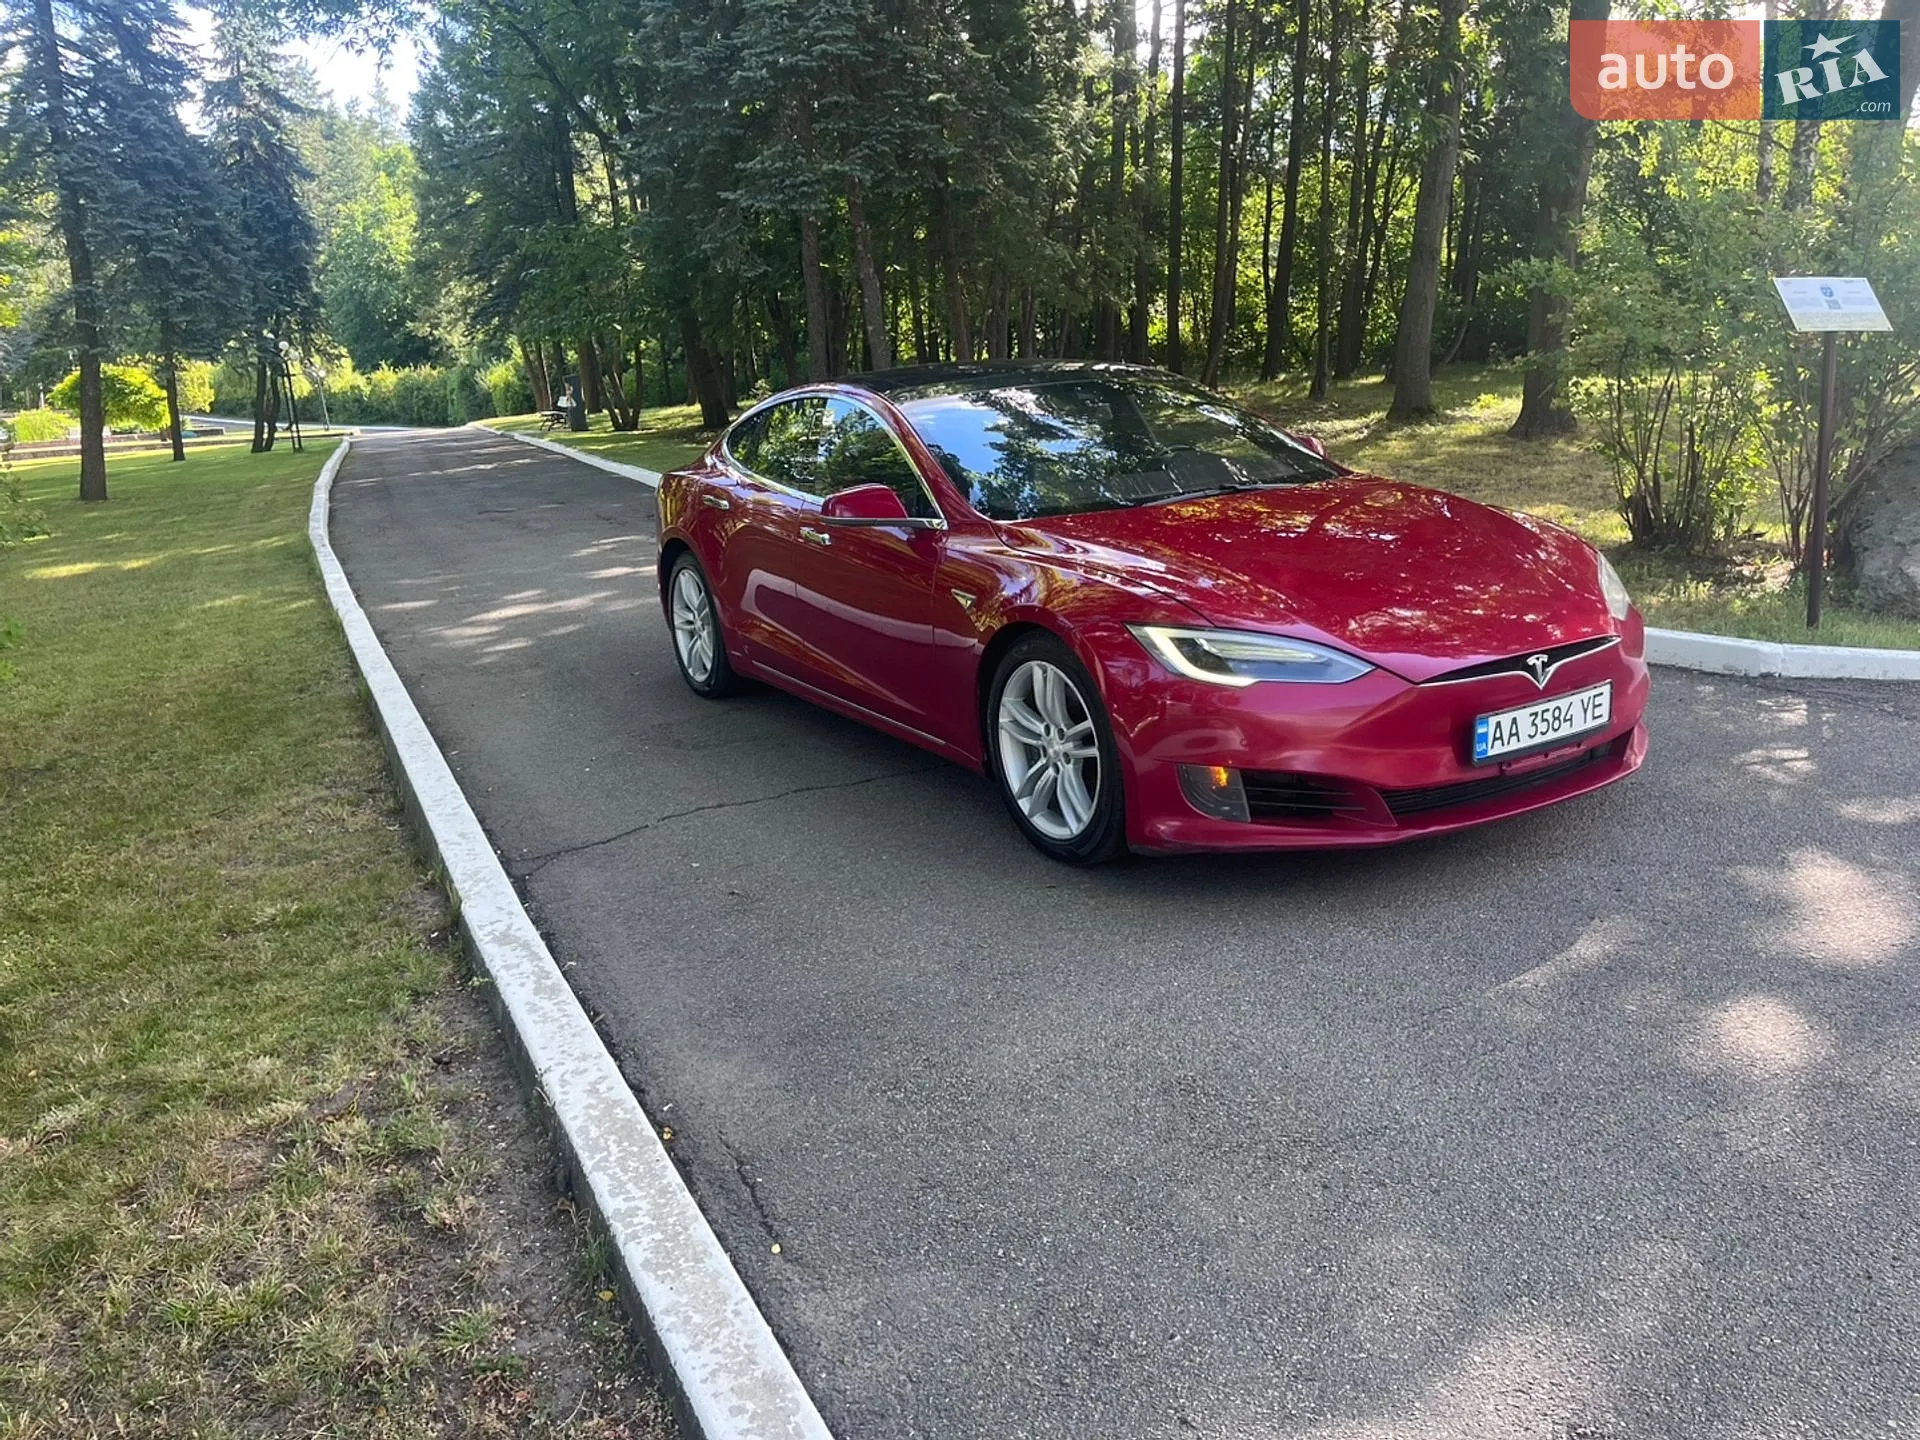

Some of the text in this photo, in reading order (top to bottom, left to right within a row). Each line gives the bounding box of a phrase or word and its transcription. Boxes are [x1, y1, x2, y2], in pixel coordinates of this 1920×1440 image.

[1490, 692, 1604, 749] AA 3584 YE
